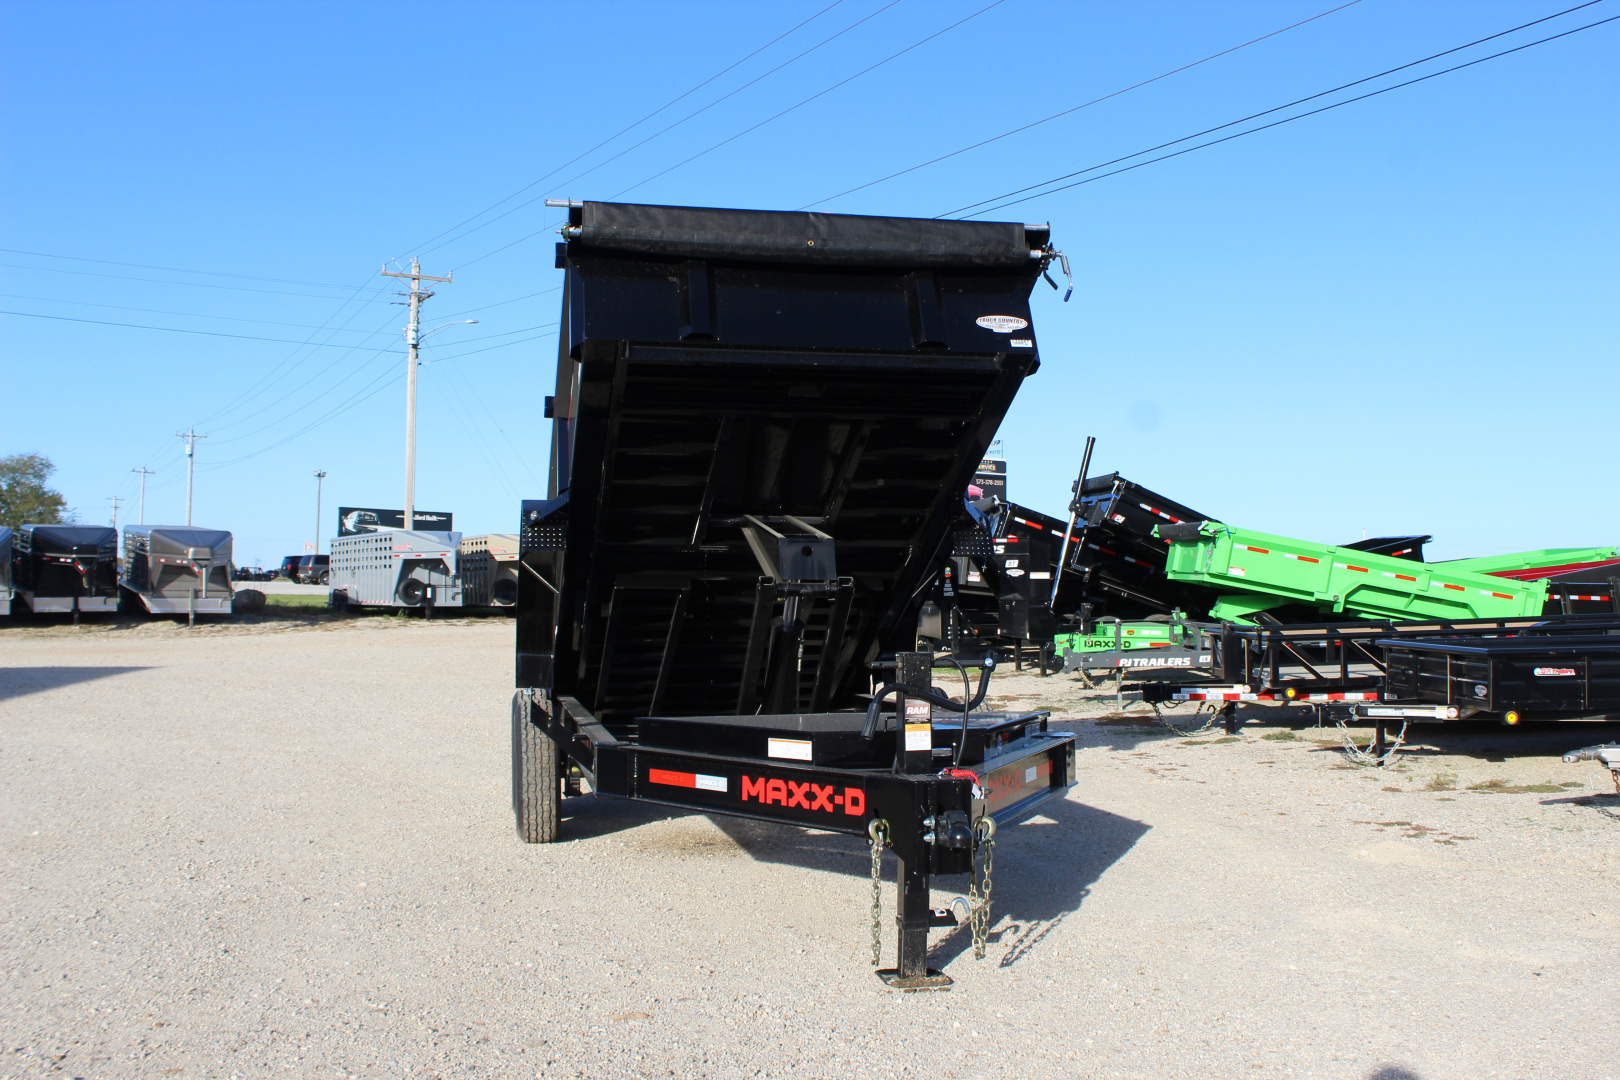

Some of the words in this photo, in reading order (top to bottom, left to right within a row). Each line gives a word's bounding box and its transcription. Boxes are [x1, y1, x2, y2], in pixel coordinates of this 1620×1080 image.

[906, 706, 929, 715] RAM
[741, 775, 865, 816] MAXX-D
[987, 768, 1022, 804] AXX-D
